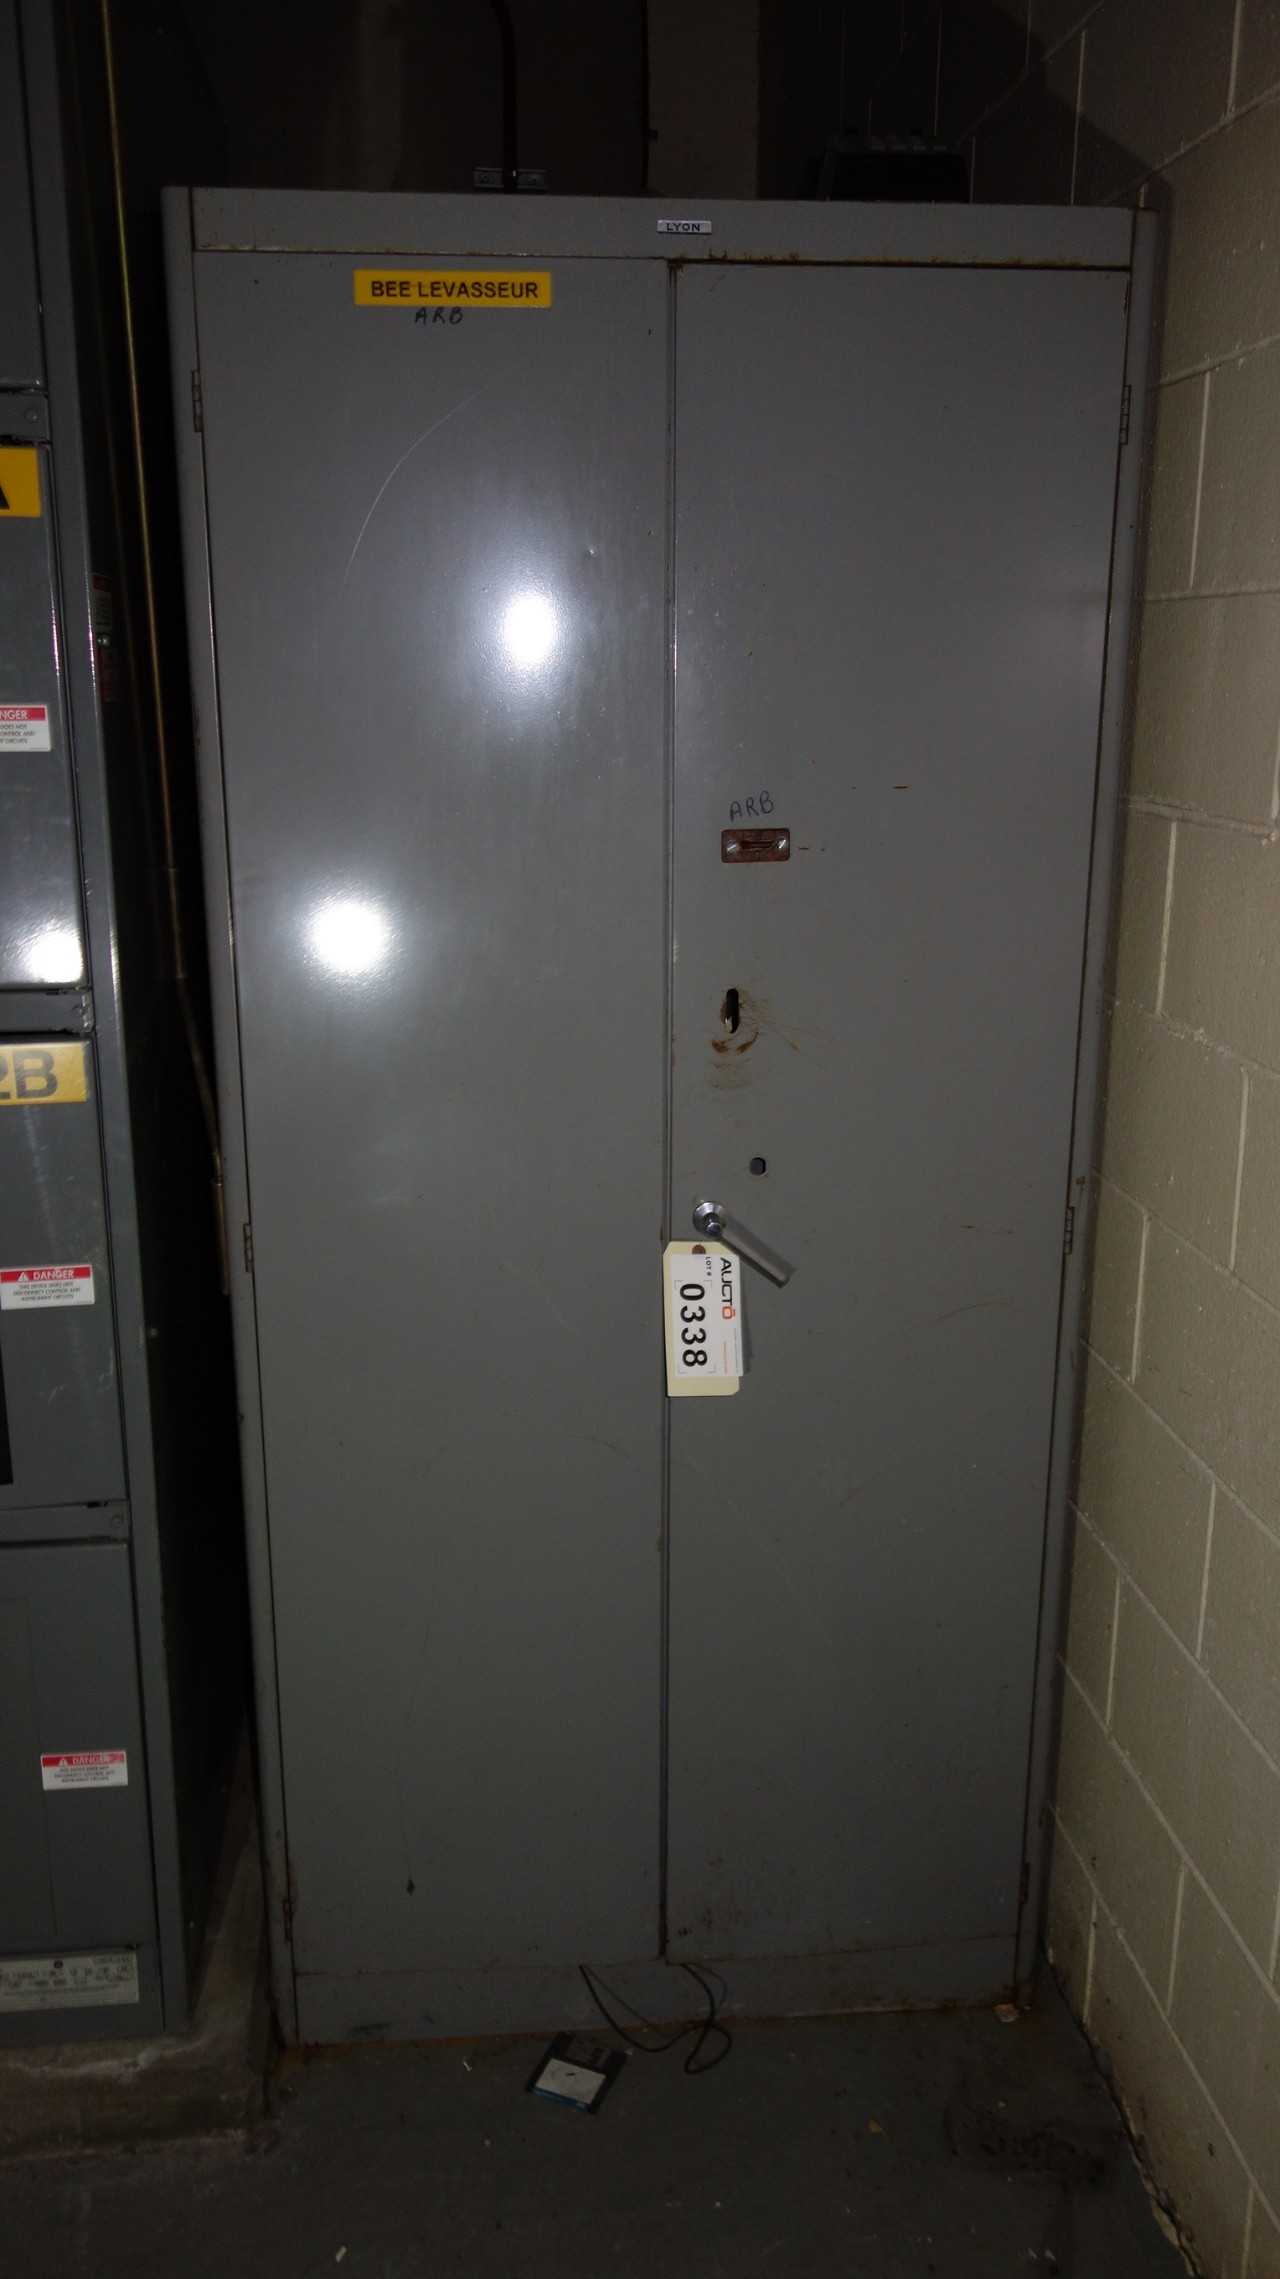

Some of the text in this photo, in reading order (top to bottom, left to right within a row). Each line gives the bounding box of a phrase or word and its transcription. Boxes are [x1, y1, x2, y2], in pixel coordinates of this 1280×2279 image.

[666, 223, 700, 231] LYON
[371, 281, 538, 298] BEE LEVASSEUR
[415, 307, 463, 325] ARB
[729, 790, 775, 822] ARB
[0, 1049, 58, 1099] B
[32, 1267, 75, 1281] DANGER
[679, 1283, 708, 1367] 0338
